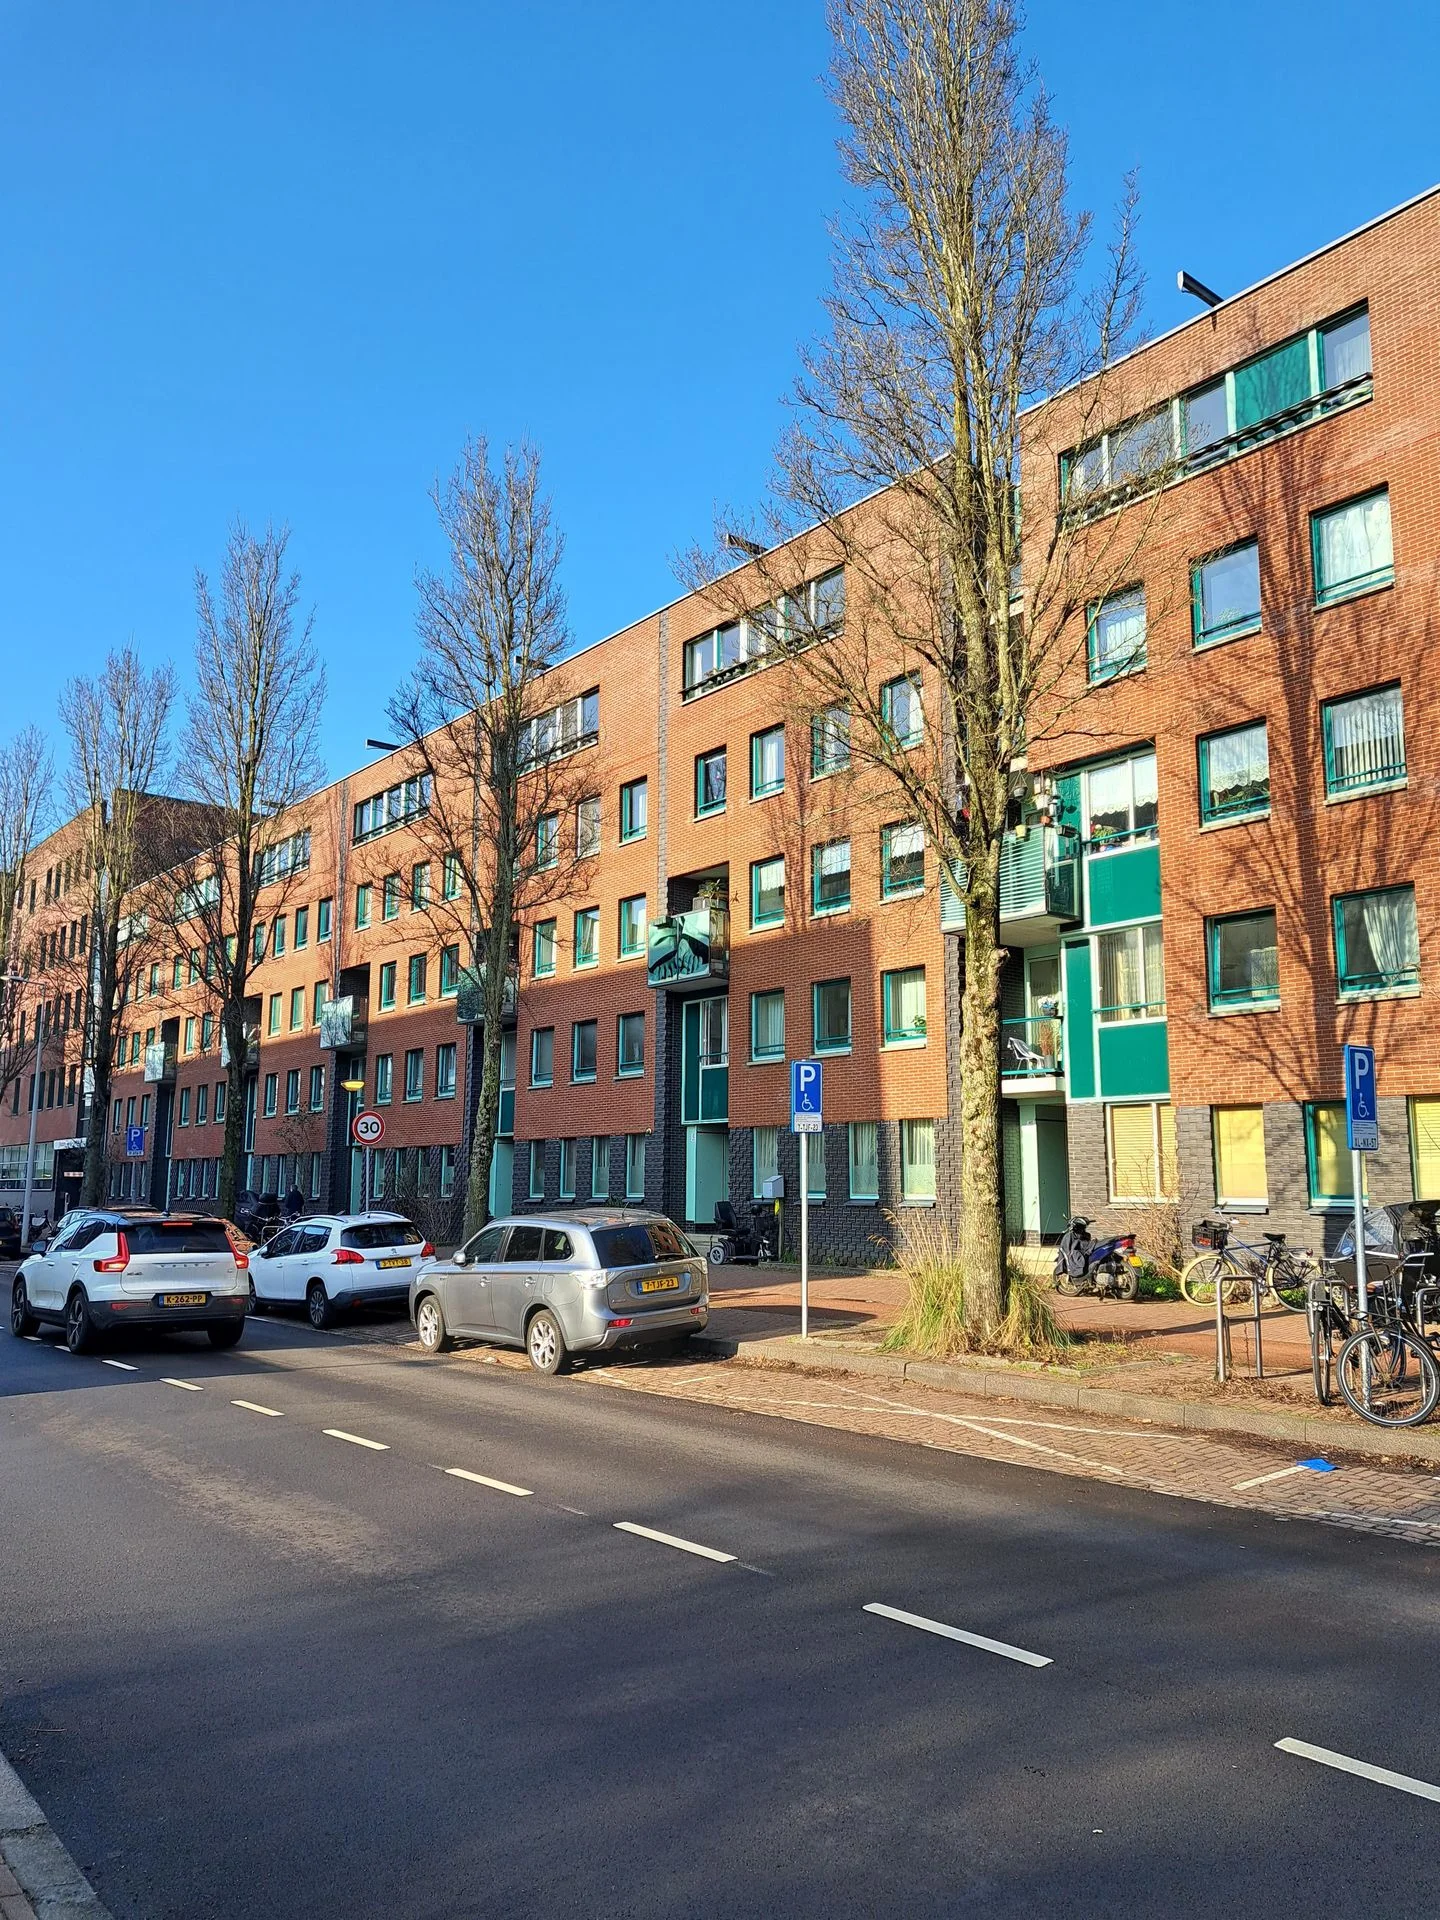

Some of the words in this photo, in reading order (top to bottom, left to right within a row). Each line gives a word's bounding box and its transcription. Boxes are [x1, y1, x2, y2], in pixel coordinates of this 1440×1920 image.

[1354, 1052, 1369, 1090] P
[800, 1065, 816, 1092] P
[360, 1121, 380, 1134] 30
[131, 1129, 141, 1142] P
[645, 1279, 675, 1290] 7-TJF-23
[166, 1295, 203, 1304] K-262-PP
